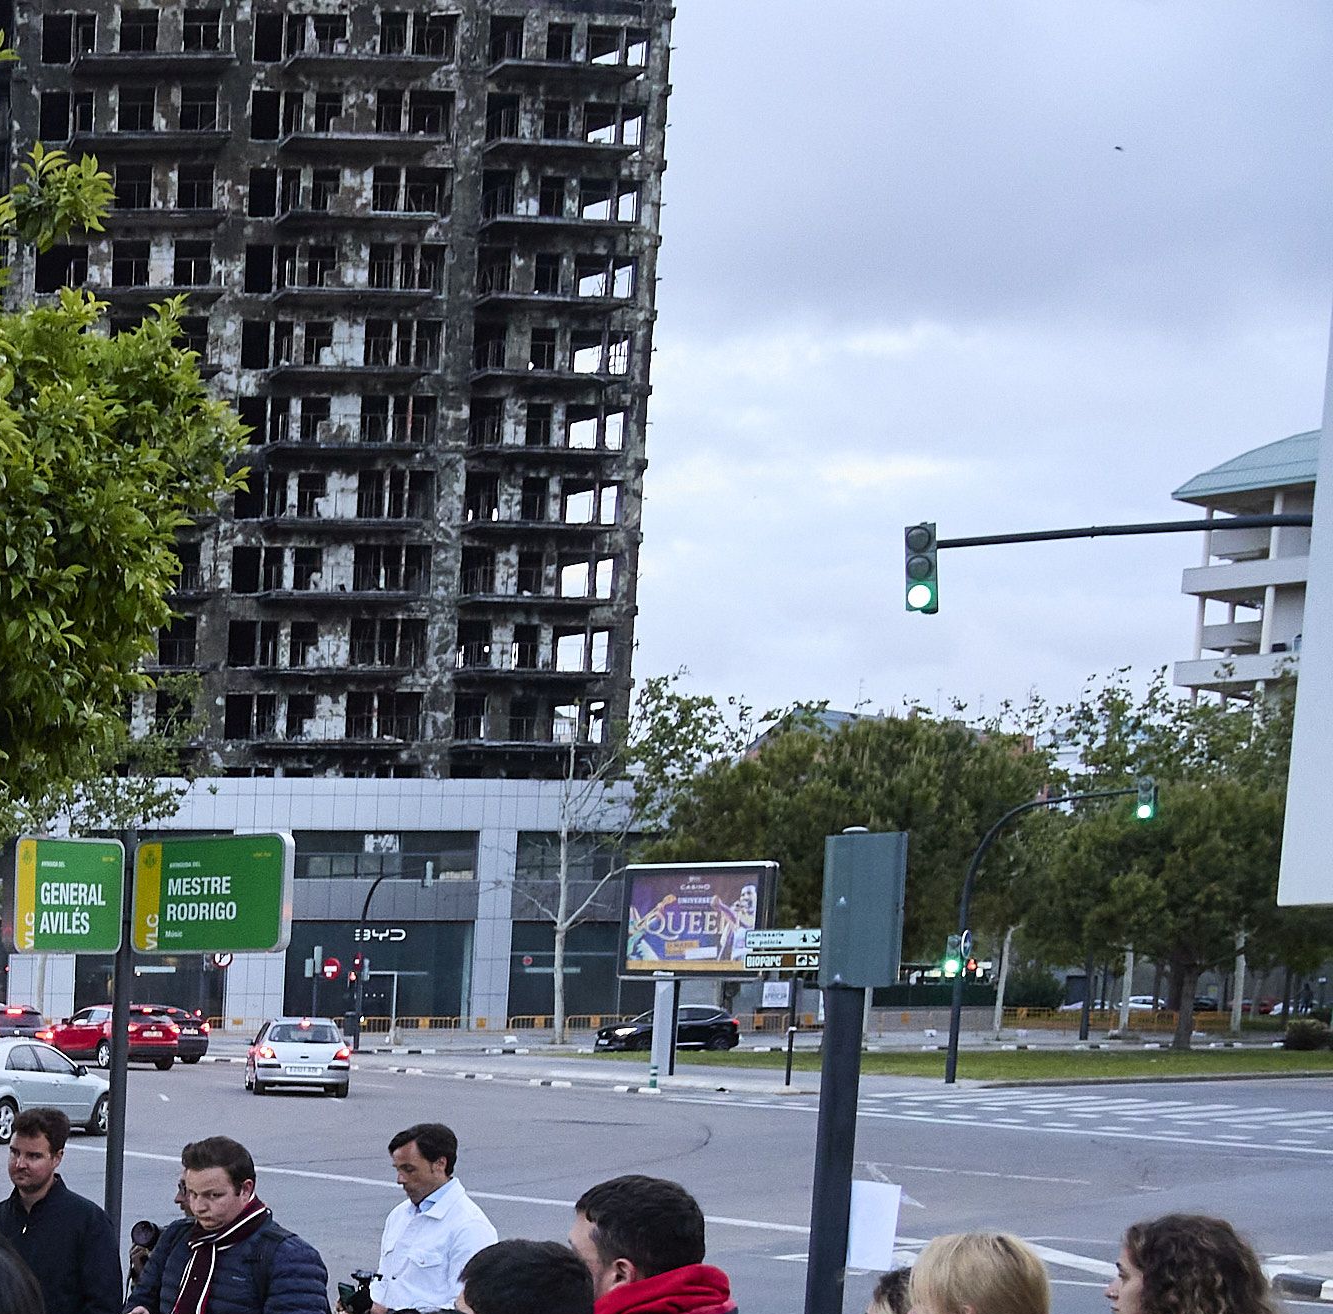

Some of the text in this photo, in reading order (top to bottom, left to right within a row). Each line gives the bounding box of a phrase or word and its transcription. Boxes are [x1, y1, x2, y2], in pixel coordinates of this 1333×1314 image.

[40, 882, 106, 906] GENERAL
[167, 876, 231, 896] MESTRE
[39, 906, 90, 935] AVILÉS
[166, 901, 237, 921] RODRIGO
[24, 912, 35, 950] VLC
[145, 913, 159, 950] VLC
[354, 928, 407, 941] BYD
